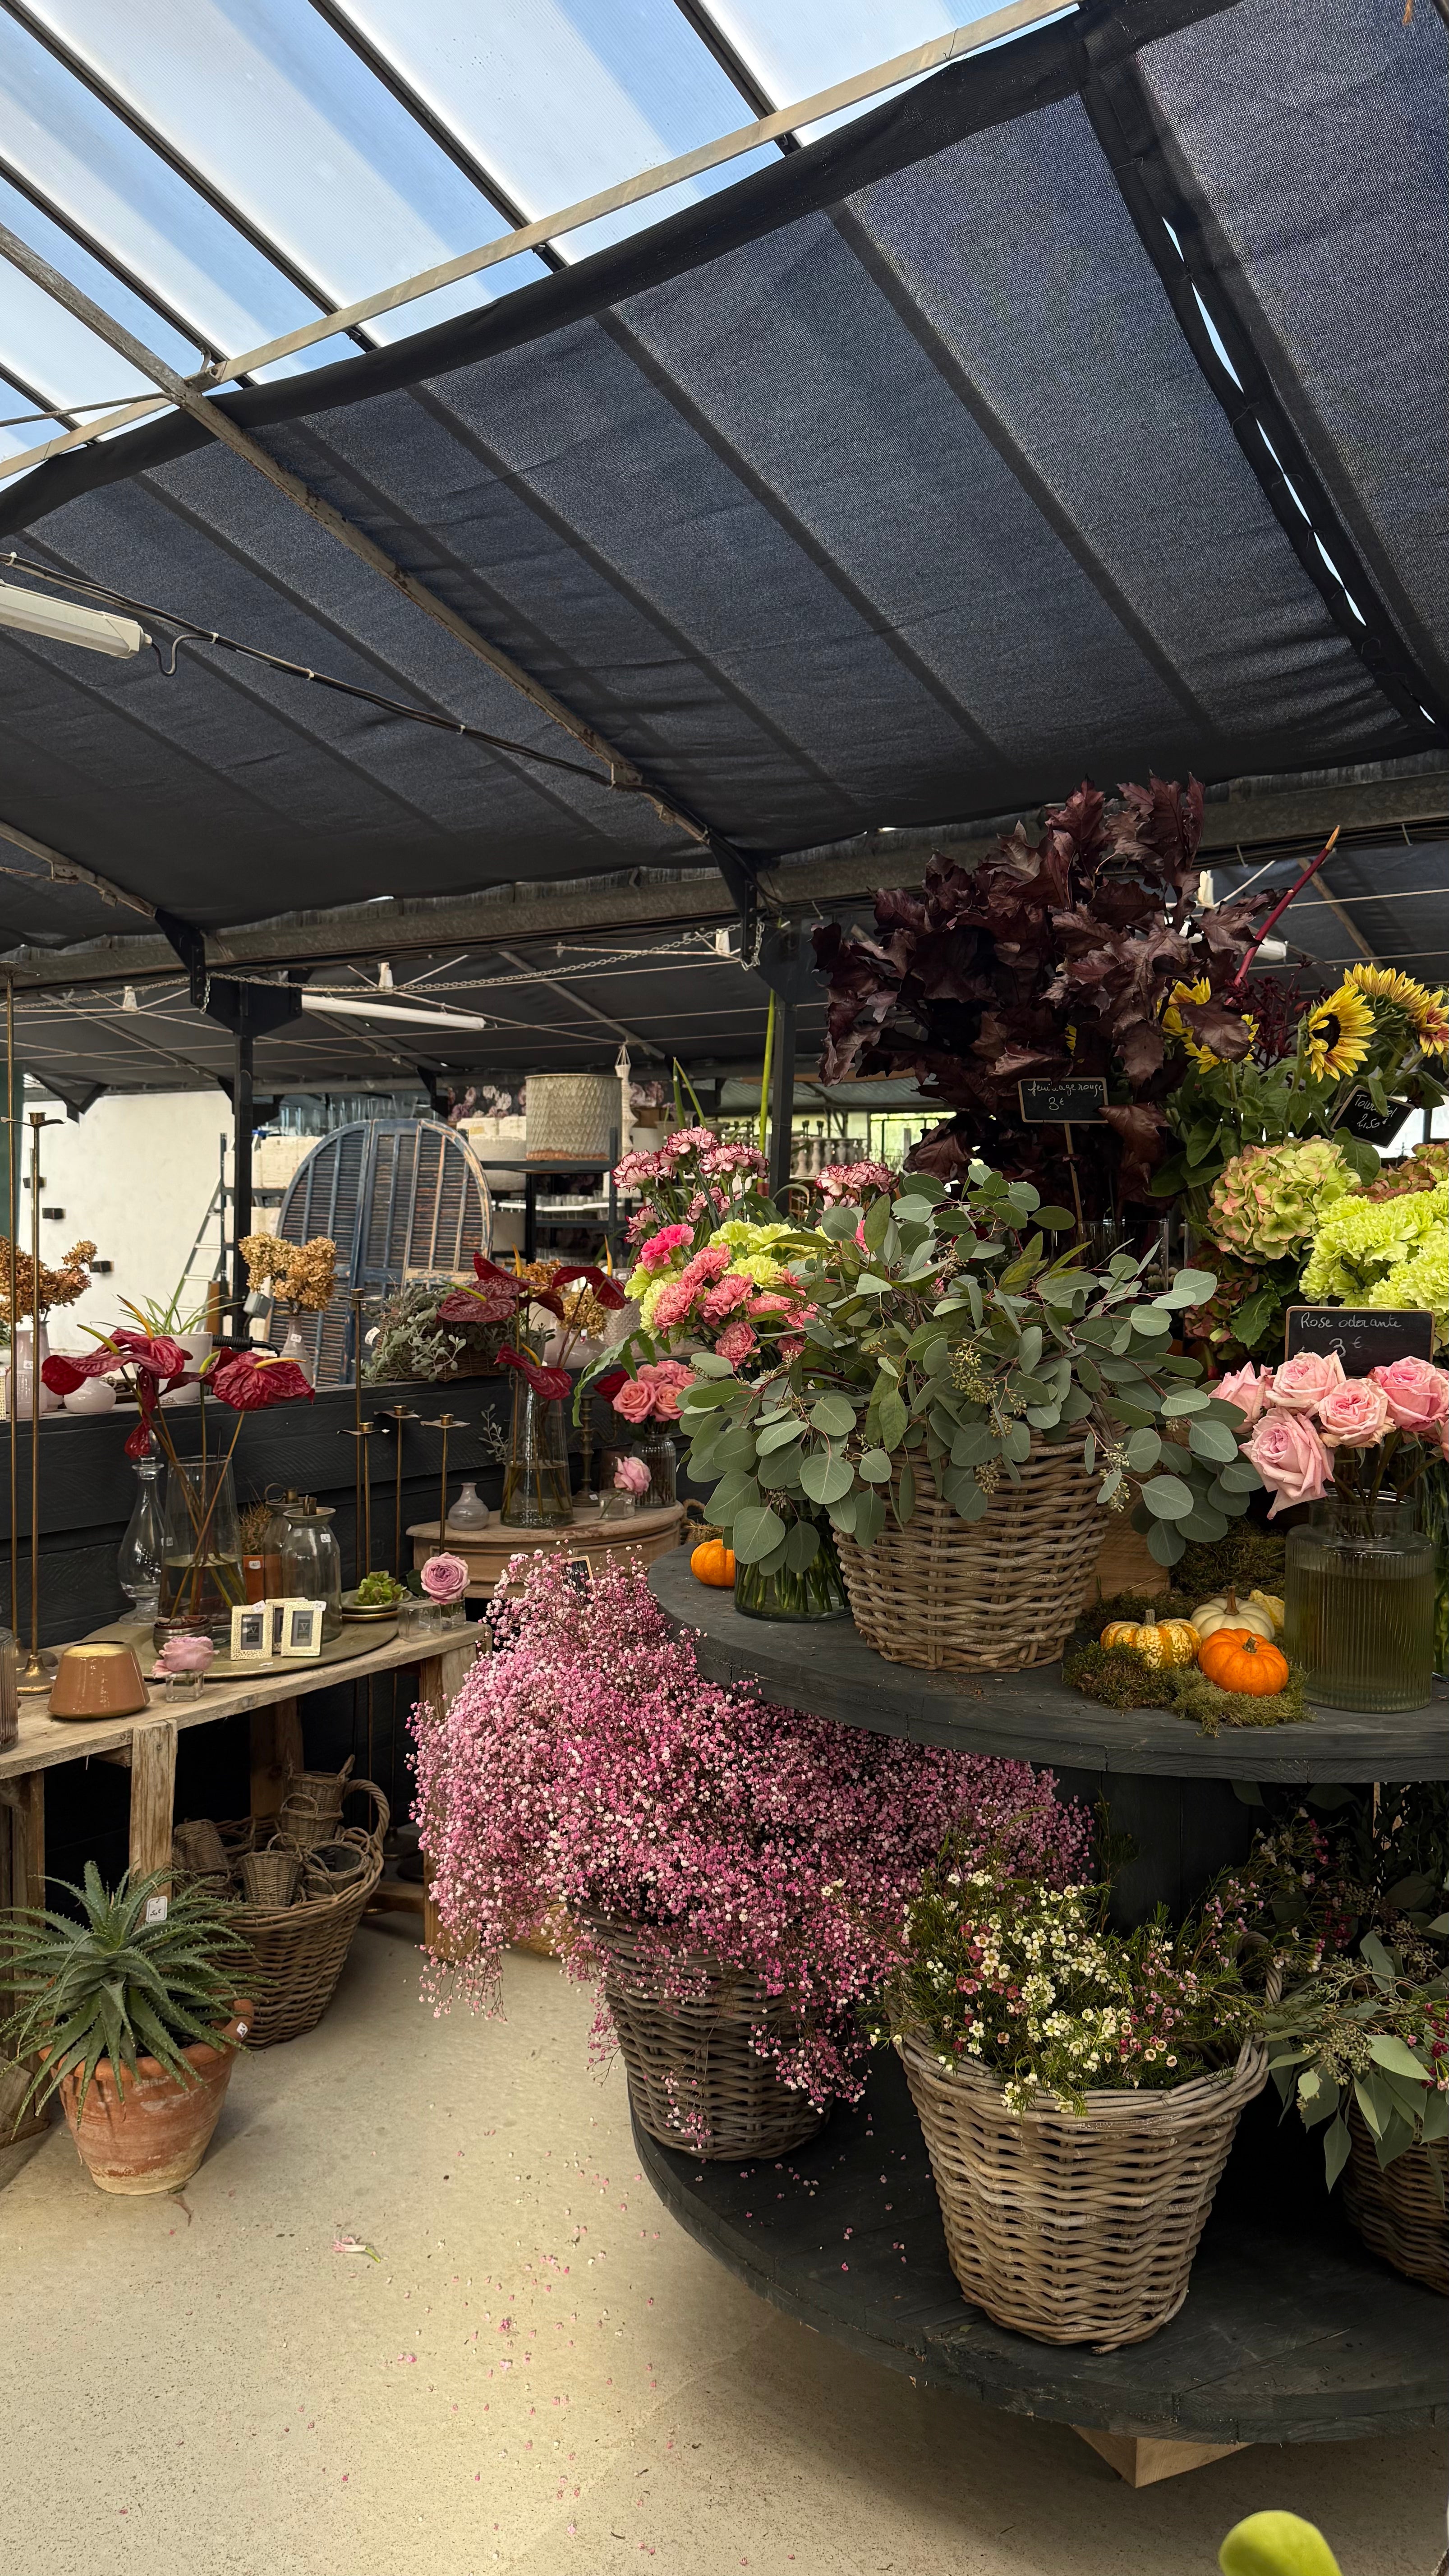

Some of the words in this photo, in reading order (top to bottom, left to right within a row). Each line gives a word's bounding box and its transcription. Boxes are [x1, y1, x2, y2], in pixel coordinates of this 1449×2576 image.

[1078, 1084, 1104, 1097] rouge
[1301, 1312, 1333, 1329] Rose
[1338, 1314, 1402, 1328] odorante
